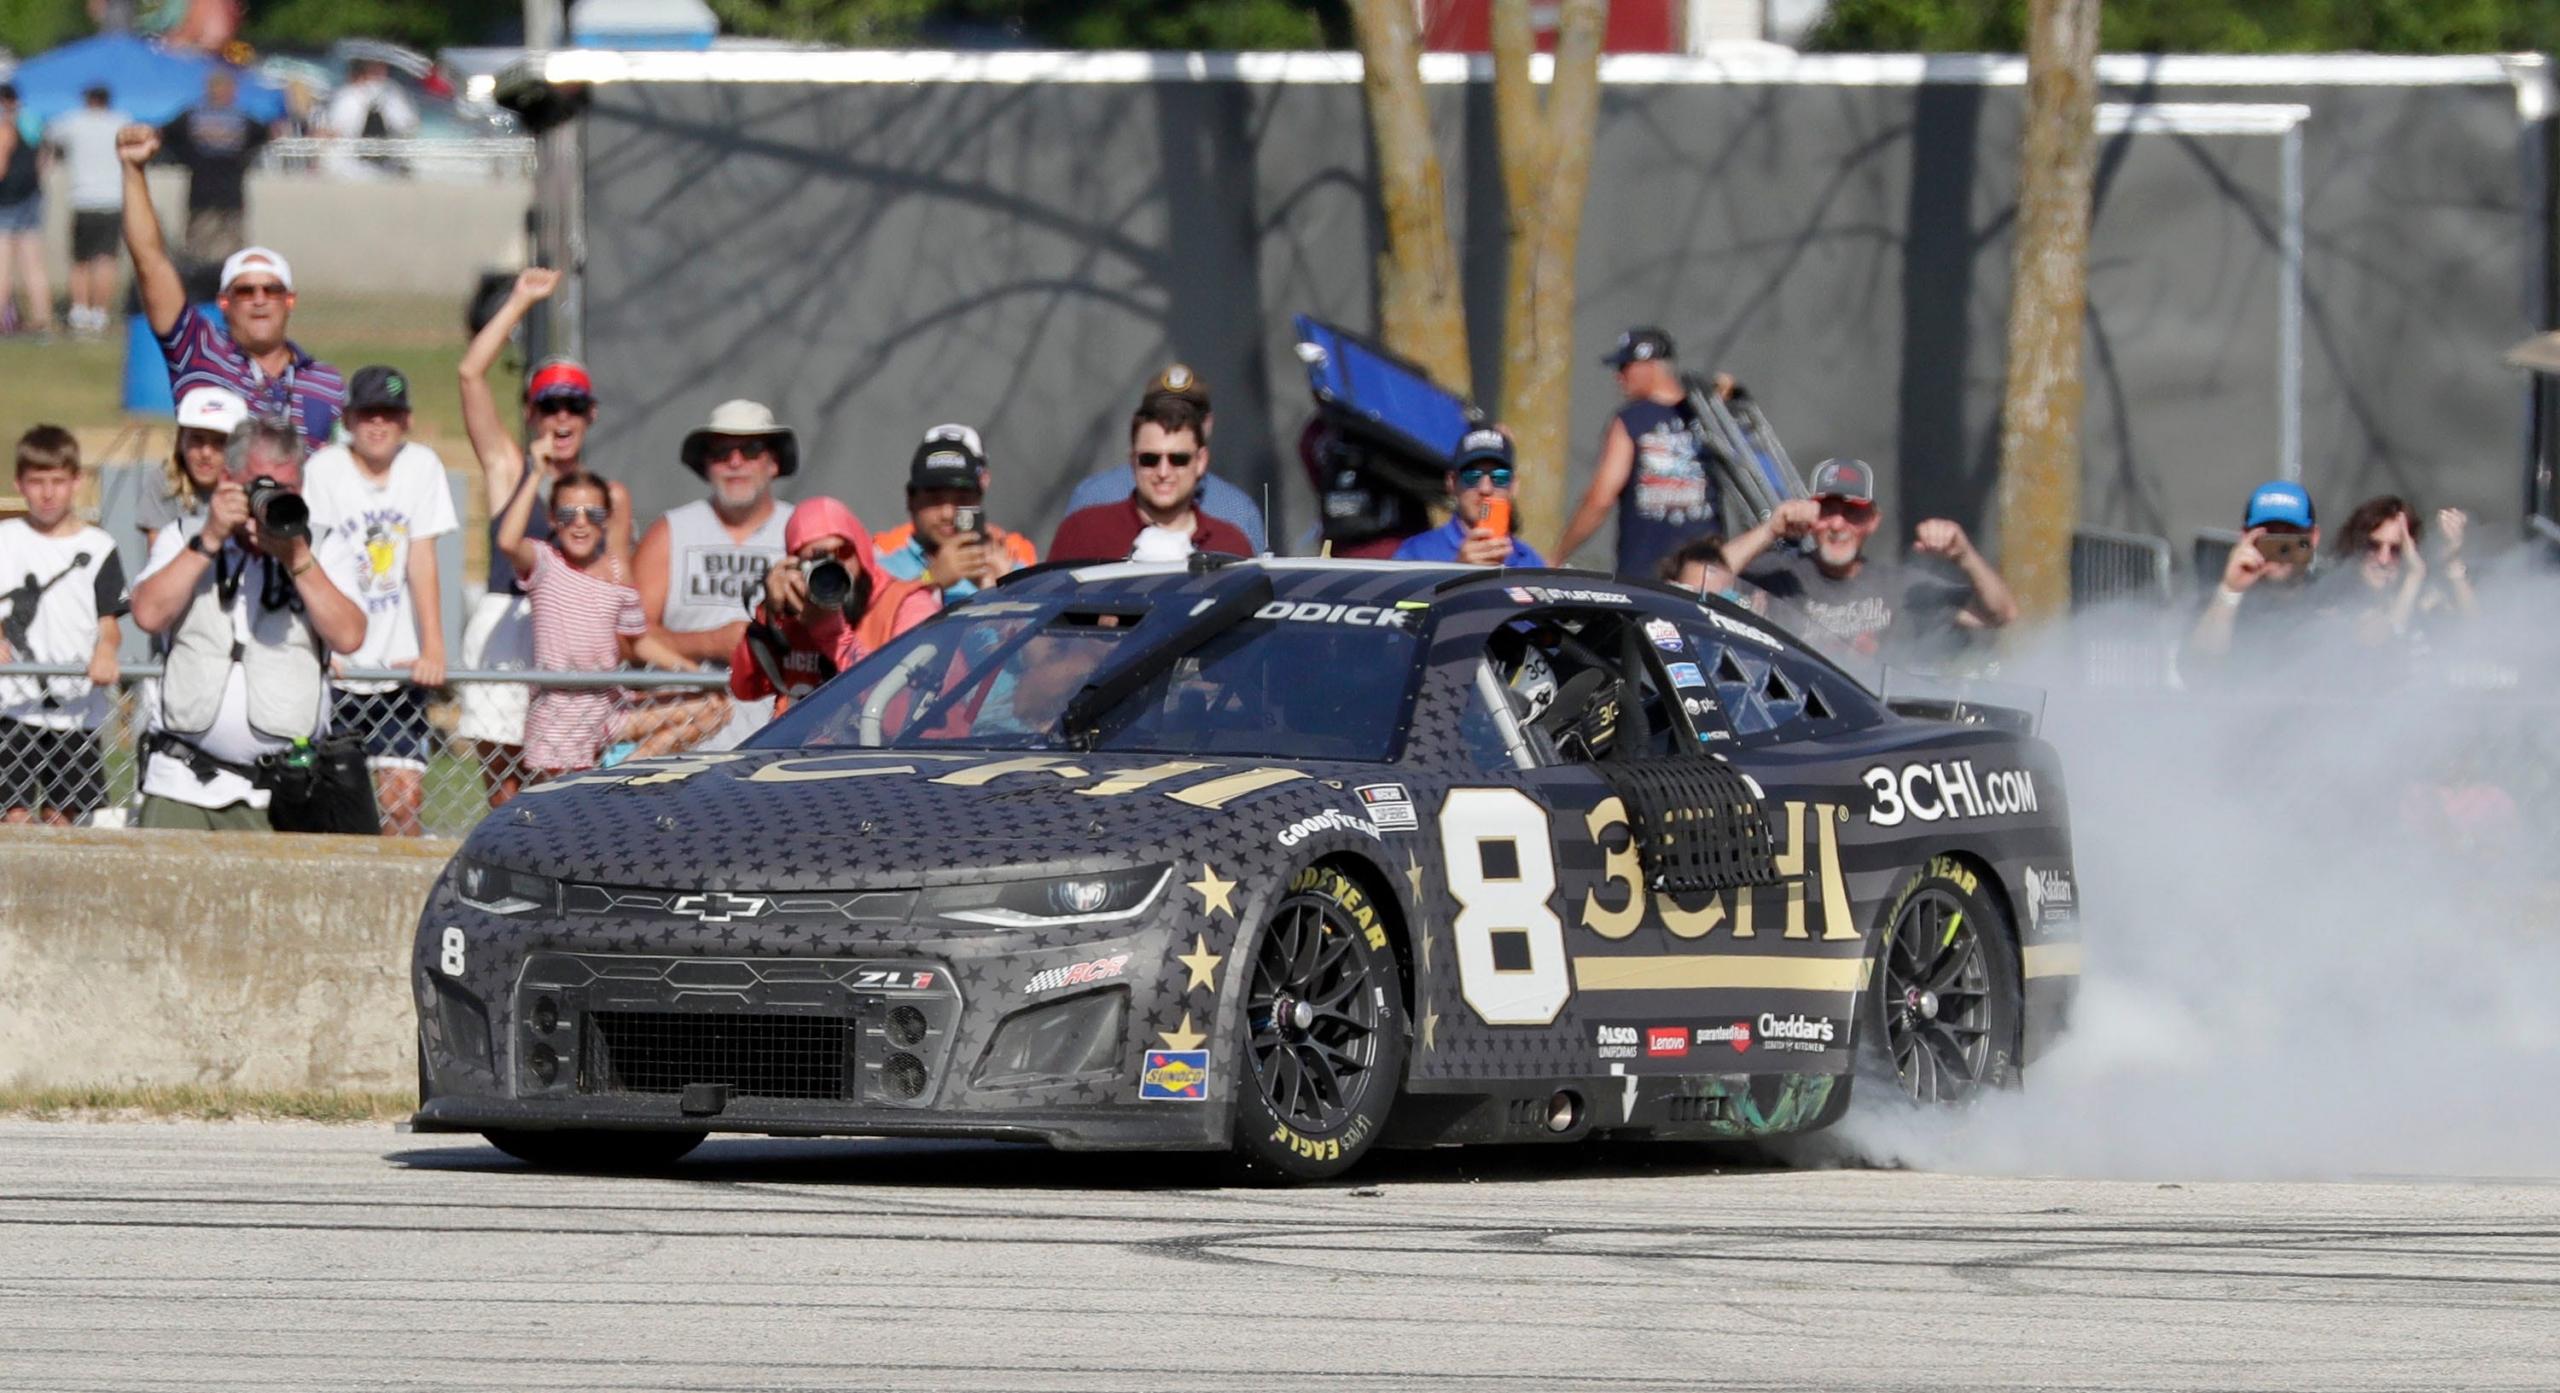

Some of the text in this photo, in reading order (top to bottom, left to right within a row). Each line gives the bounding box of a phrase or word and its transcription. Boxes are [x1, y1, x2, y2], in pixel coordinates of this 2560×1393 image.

[704, 555, 769, 574] BUD
[690, 574, 762, 598] LIGH
[1188, 598, 1409, 628] DDICK
[1861, 759, 2038, 826] 3CHI.COM
[1277, 808, 1382, 846] GOODYEAR
[1438, 786, 1571, 1026] 8
[441, 926, 465, 977] 8
[852, 971, 935, 989] ZL1
[1758, 1012, 1834, 1041] Cheddar's
[1650, 1034, 1686, 1051] Lenovo
[1145, 1068, 1206, 1084] SUNOCO
[1274, 1121, 1340, 1161] EAGLE
